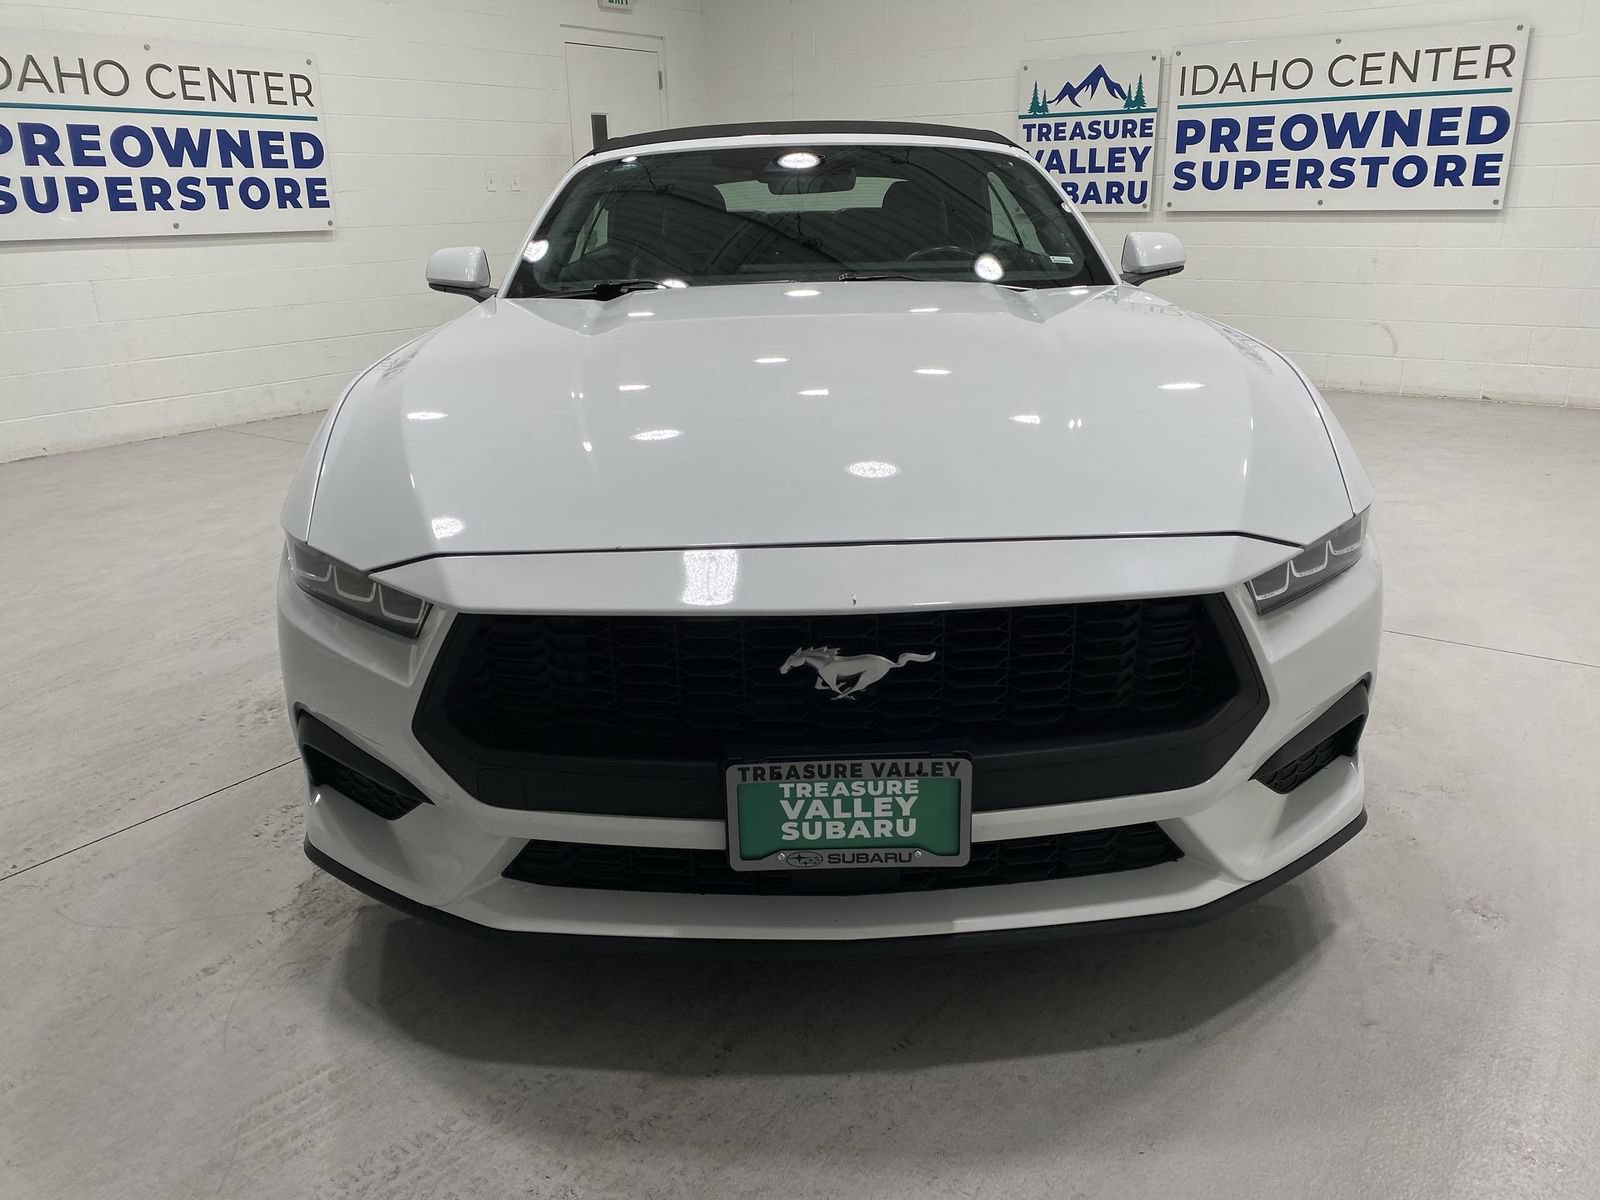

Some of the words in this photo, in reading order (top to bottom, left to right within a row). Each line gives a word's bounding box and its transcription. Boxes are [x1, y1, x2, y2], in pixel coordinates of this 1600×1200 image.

[0, 55, 130, 97] AHO
[145, 63, 315, 107] CENTER
[1179, 57, 1314, 96] IDAHO
[1328, 43, 1517, 86] CENTER
[1022, 118, 1154, 142] TREASURE
[1175, 105, 1512, 154] PREOWNED
[1172, 153, 1504, 191] SUPERSTORE
[1061, 180, 1148, 204] BARU
[738, 762, 863, 782] TREASURE
[871, 761, 961, 778] VALLEY
[779, 779, 919, 798] TREASURE
[779, 796, 918, 820] VALLEY
[781, 818, 917, 841] SUBARU
[827, 852, 912, 864] SUBARU
